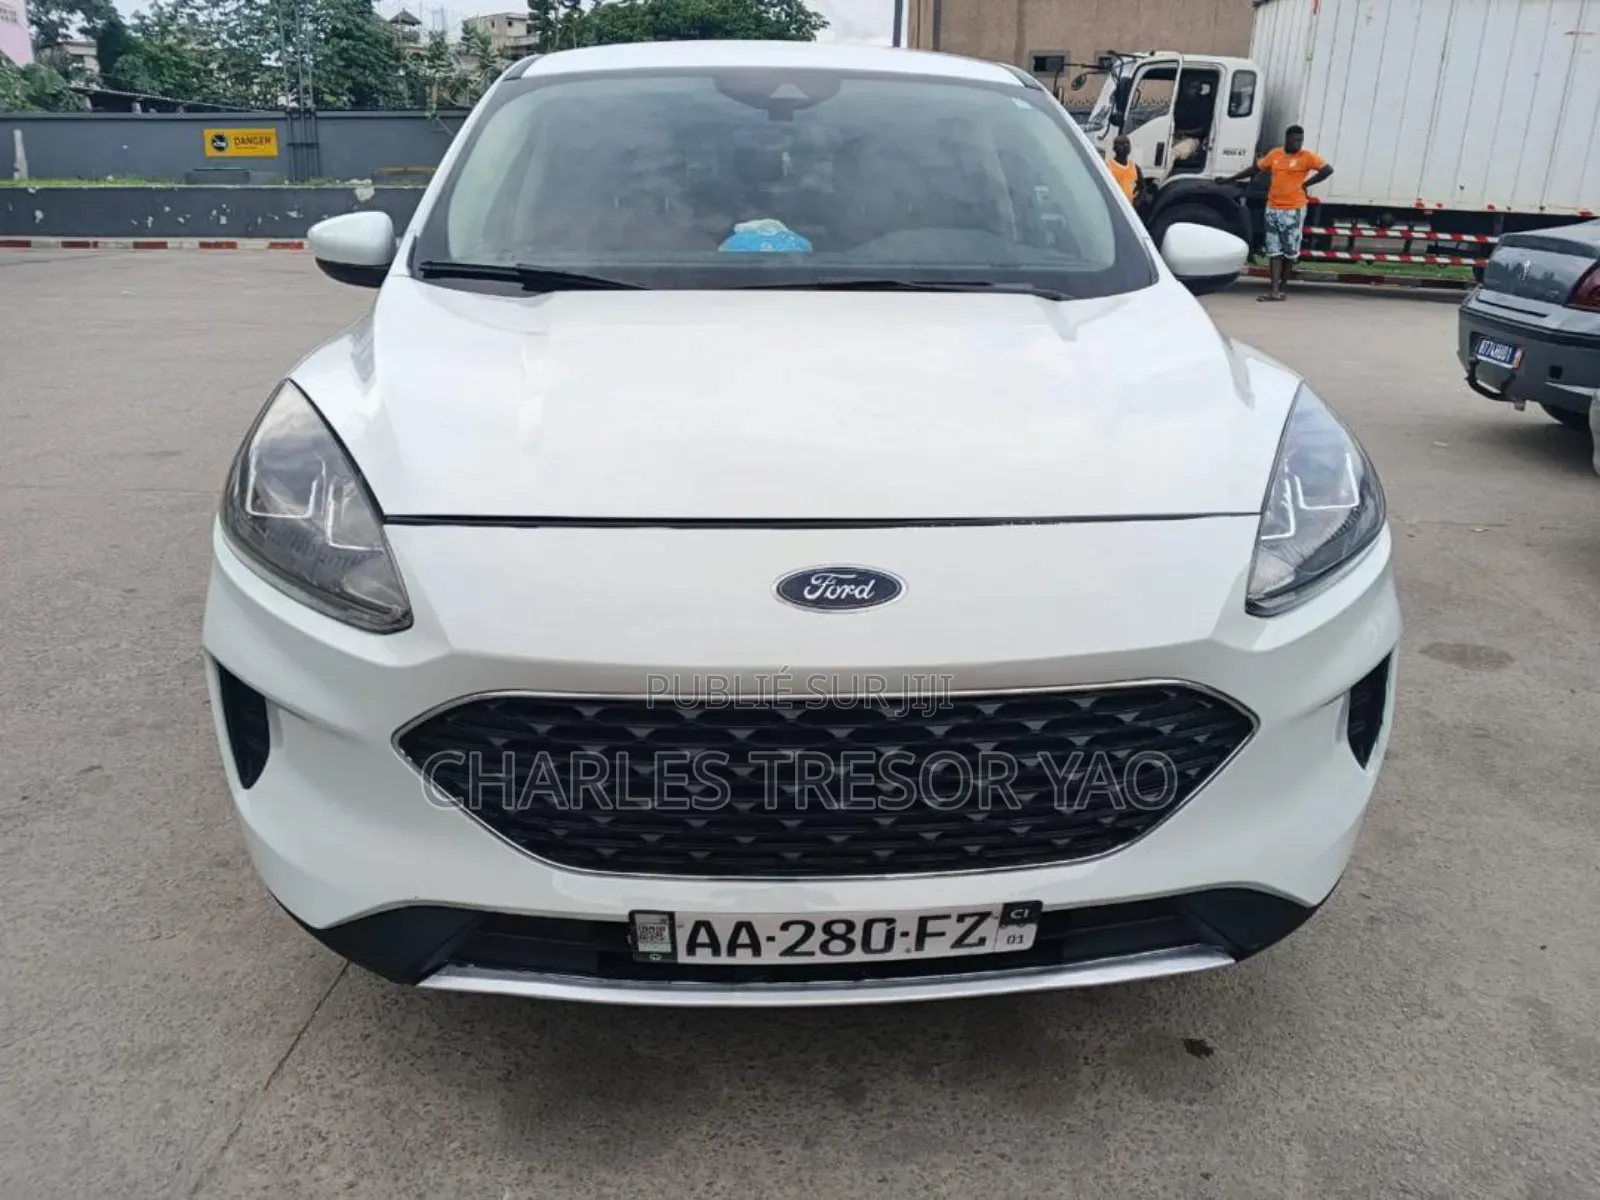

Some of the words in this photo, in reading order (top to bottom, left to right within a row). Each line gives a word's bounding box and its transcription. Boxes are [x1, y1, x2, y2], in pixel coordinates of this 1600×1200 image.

[233, 135, 272, 146] DANGER
[803, 572, 876, 600] Ford
[1010, 908, 1029, 919] CI
[1006, 934, 1024, 945] 01
